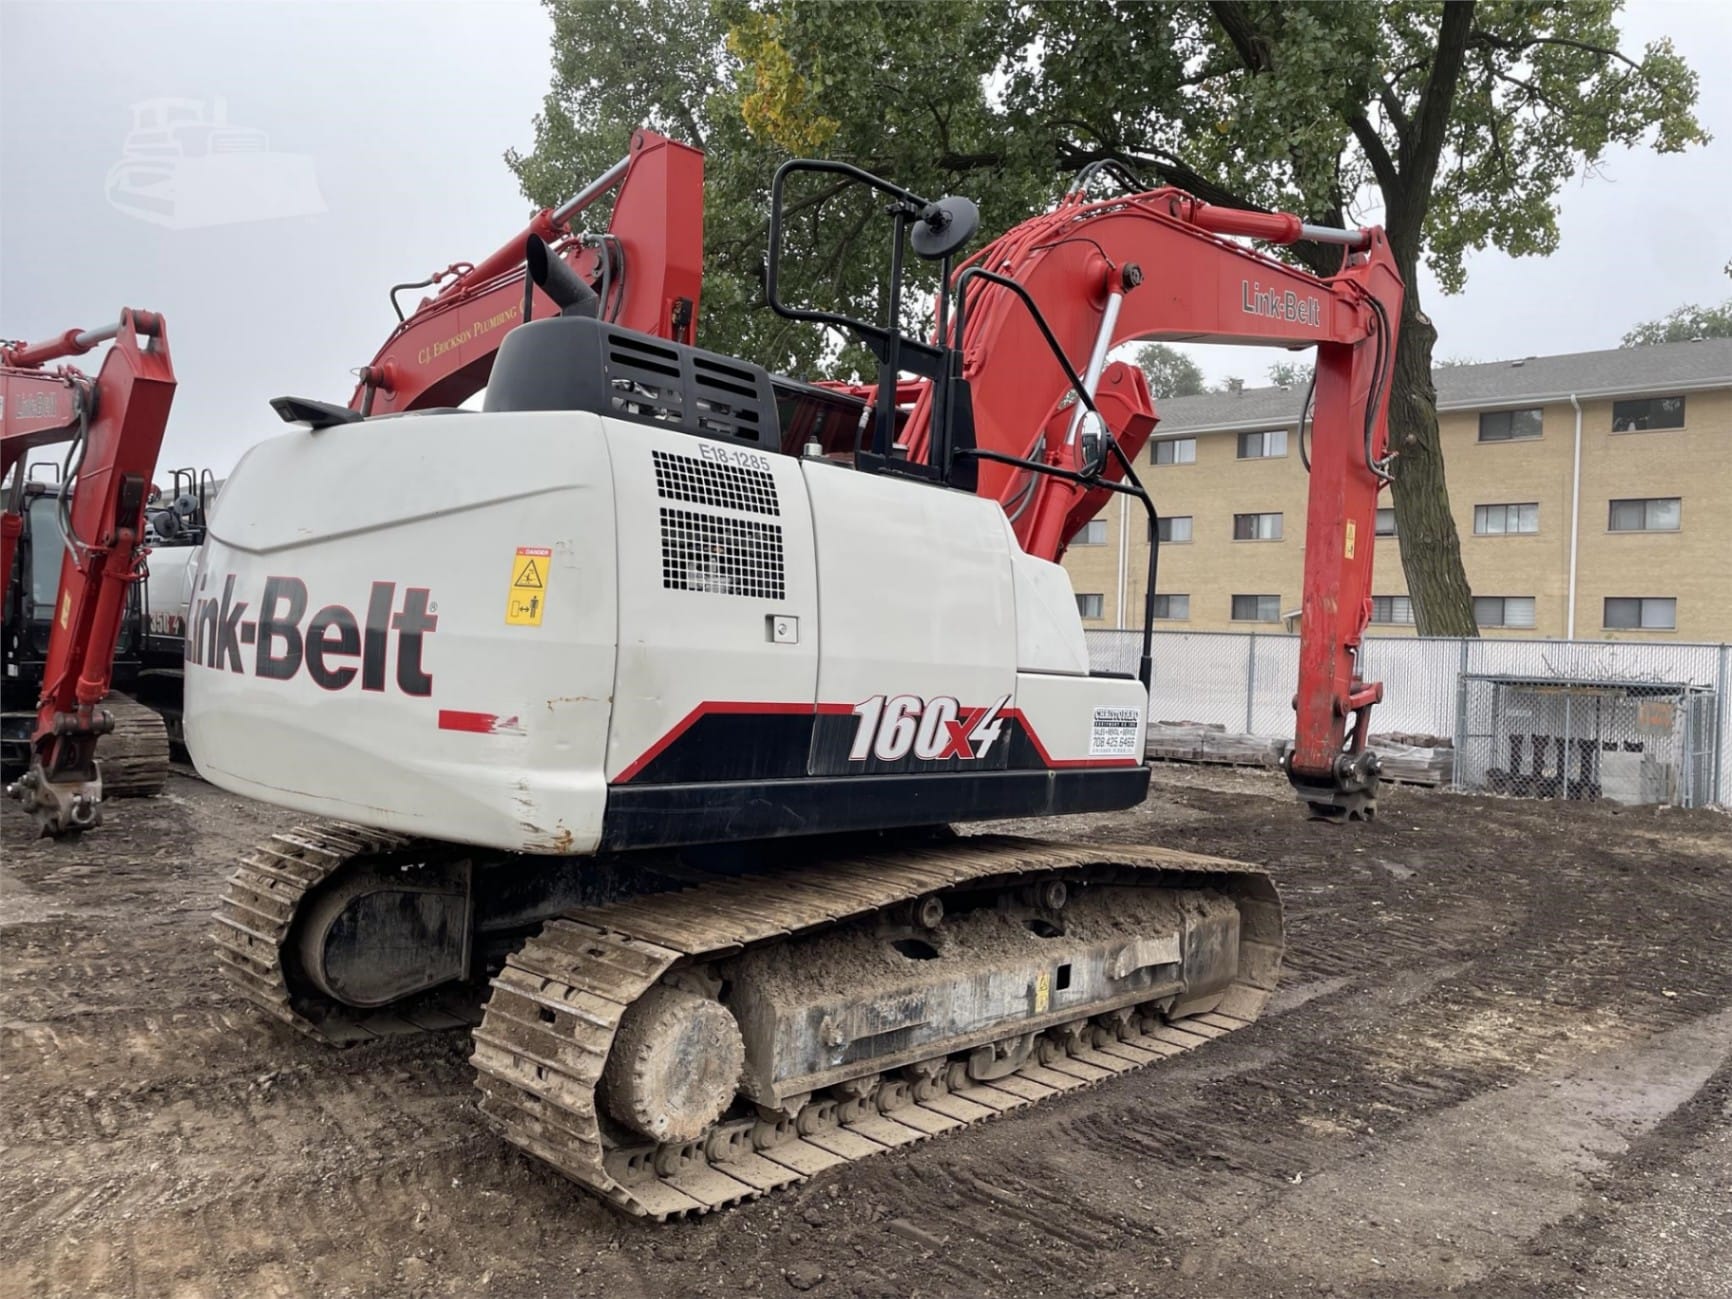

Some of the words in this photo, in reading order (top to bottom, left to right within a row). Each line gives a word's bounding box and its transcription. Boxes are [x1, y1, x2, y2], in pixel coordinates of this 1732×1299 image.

[1242, 280, 1320, 328] Link-Belt
[473, 305, 517, 337] PLUMBING
[698, 443, 770, 471] E18-1285
